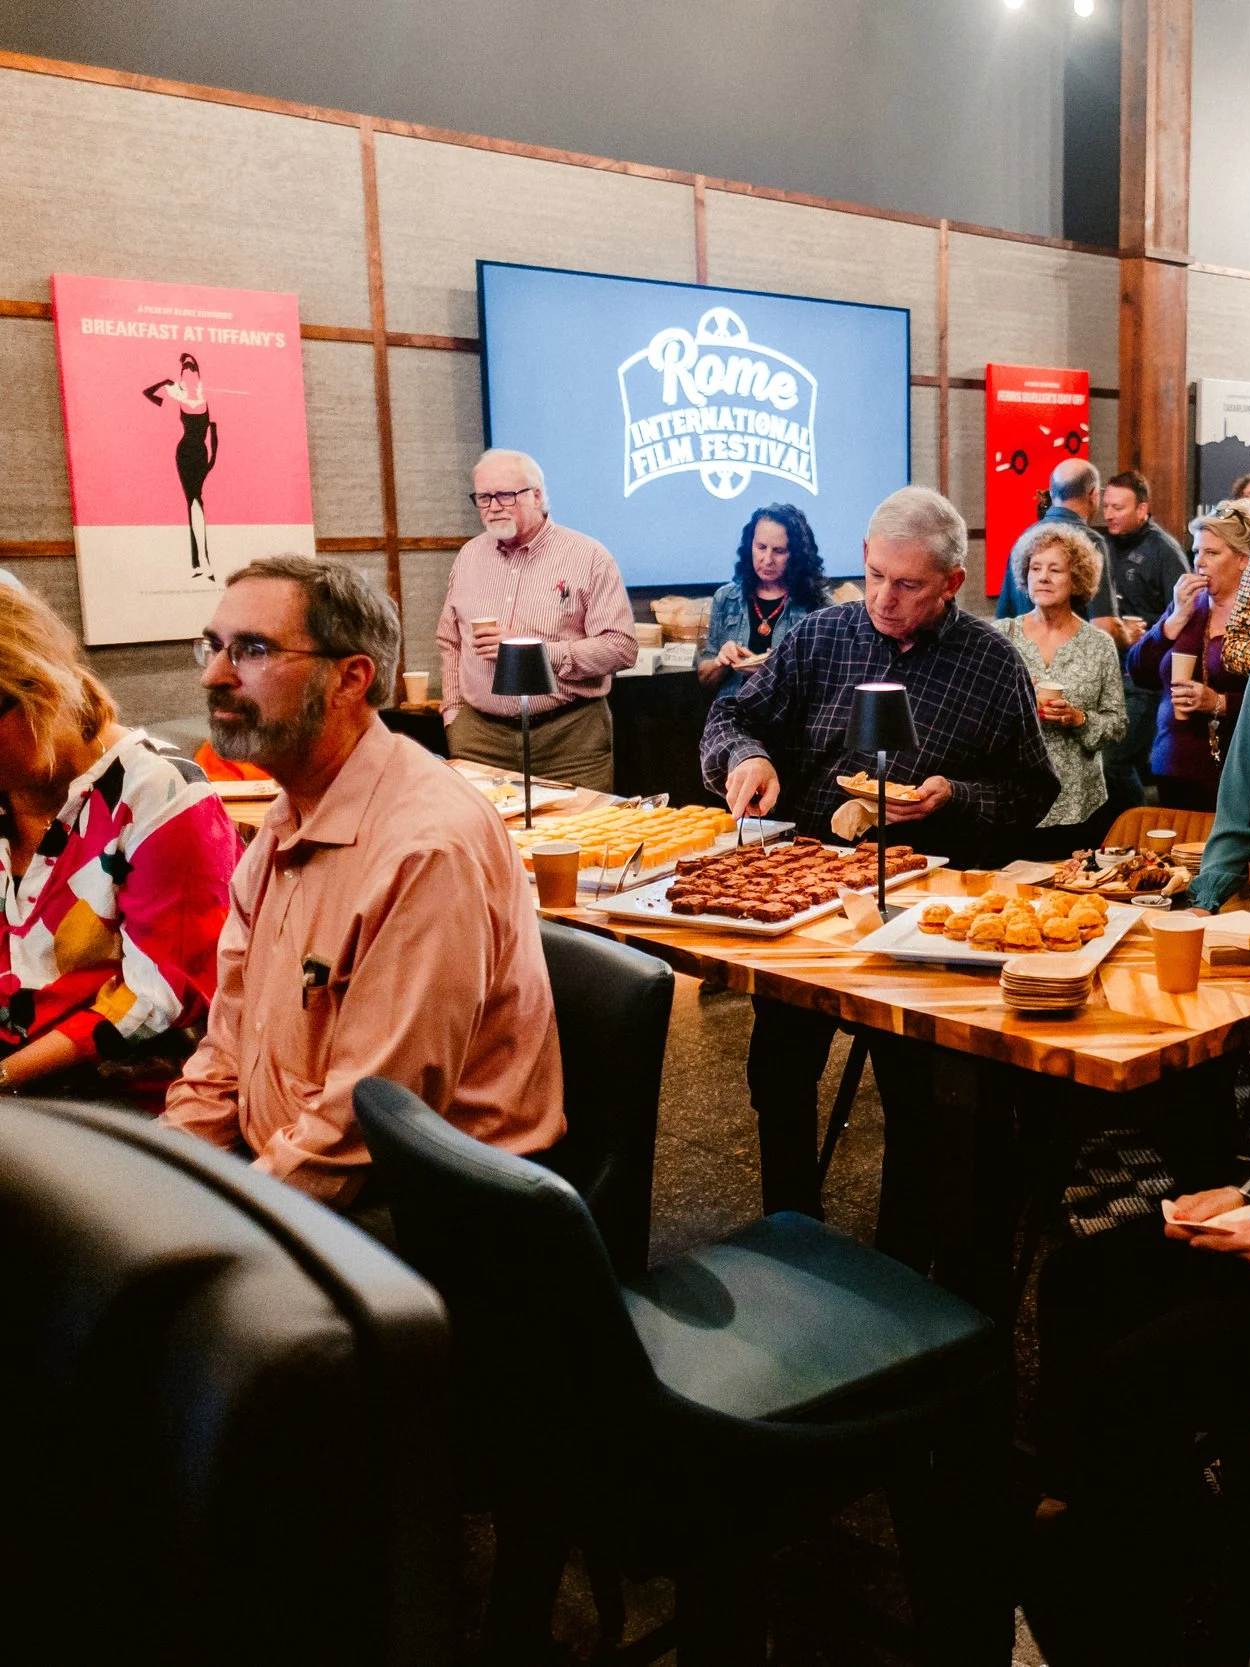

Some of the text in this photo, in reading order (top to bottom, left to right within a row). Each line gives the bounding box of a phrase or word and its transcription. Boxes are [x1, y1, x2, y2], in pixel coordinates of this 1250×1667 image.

[81, 317, 286, 348] BREAKFAST AT TIFFANY'S
[647, 327, 799, 411] Rome
[630, 406, 811, 452] INTERNATIONAL
[631, 433, 811, 480] FILM FESTIVAL
